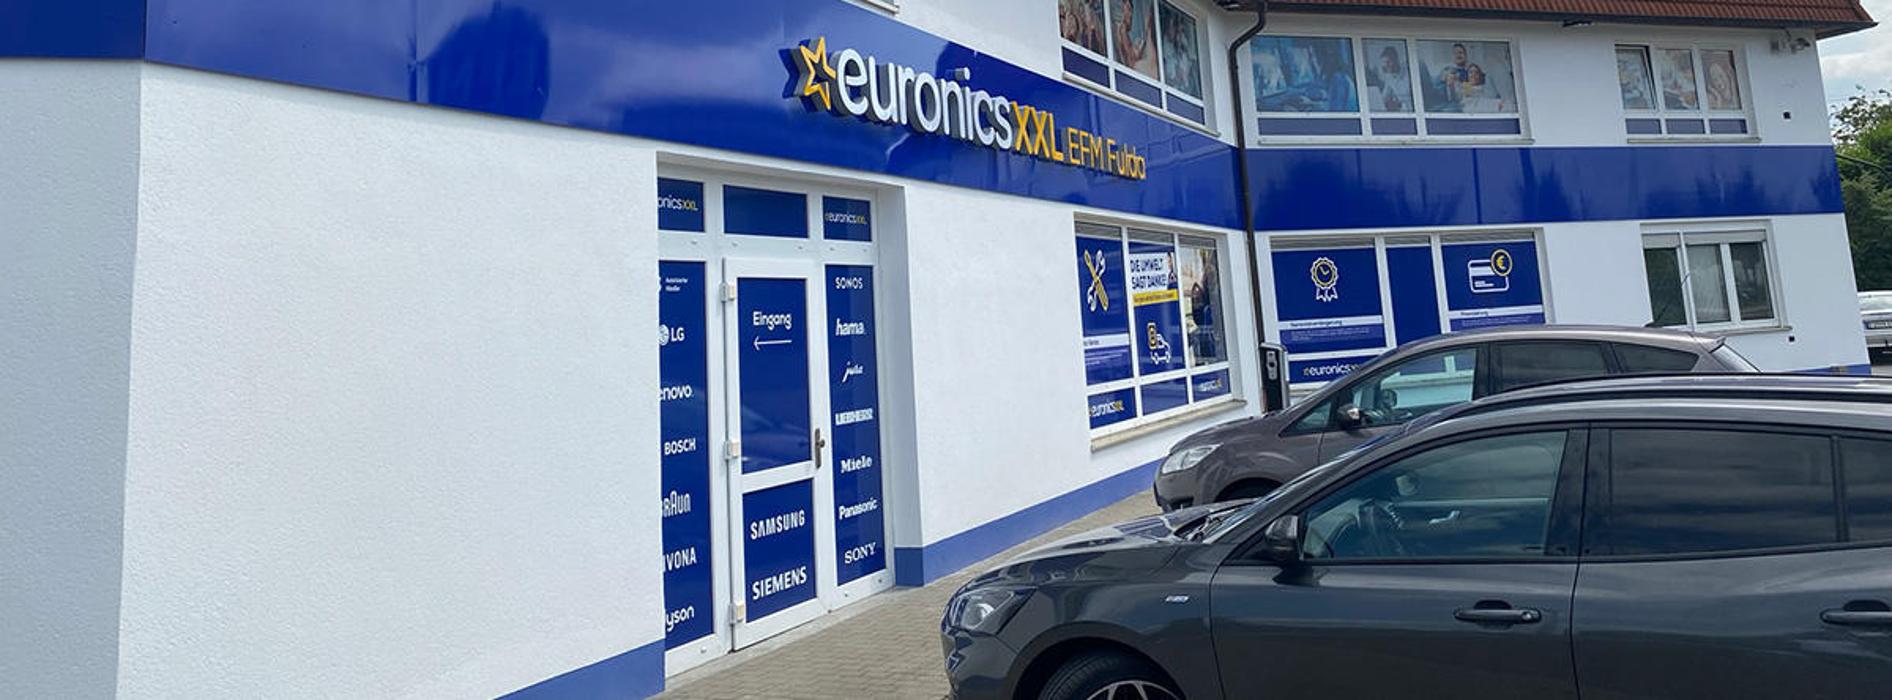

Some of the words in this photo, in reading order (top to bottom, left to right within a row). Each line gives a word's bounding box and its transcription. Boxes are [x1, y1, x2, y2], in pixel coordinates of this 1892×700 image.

[1067, 127, 1102, 166] EFM
[1107, 139, 1146, 180] Fulda
[835, 277, 864, 290] SONOS
[753, 311, 792, 331] Eingang
[835, 318, 865, 336] hama
[671, 327, 685, 342] LG
[664, 438, 696, 456] BOSCH
[840, 455, 873, 473] Miele
[661, 490, 691, 517] RAUN
[839, 498, 878, 520] Panasonic
[750, 509, 805, 540] SAMSUNG
[844, 542, 877, 564] SONY
[752, 566, 807, 600] SIEMENS
[664, 605, 694, 631] yson
